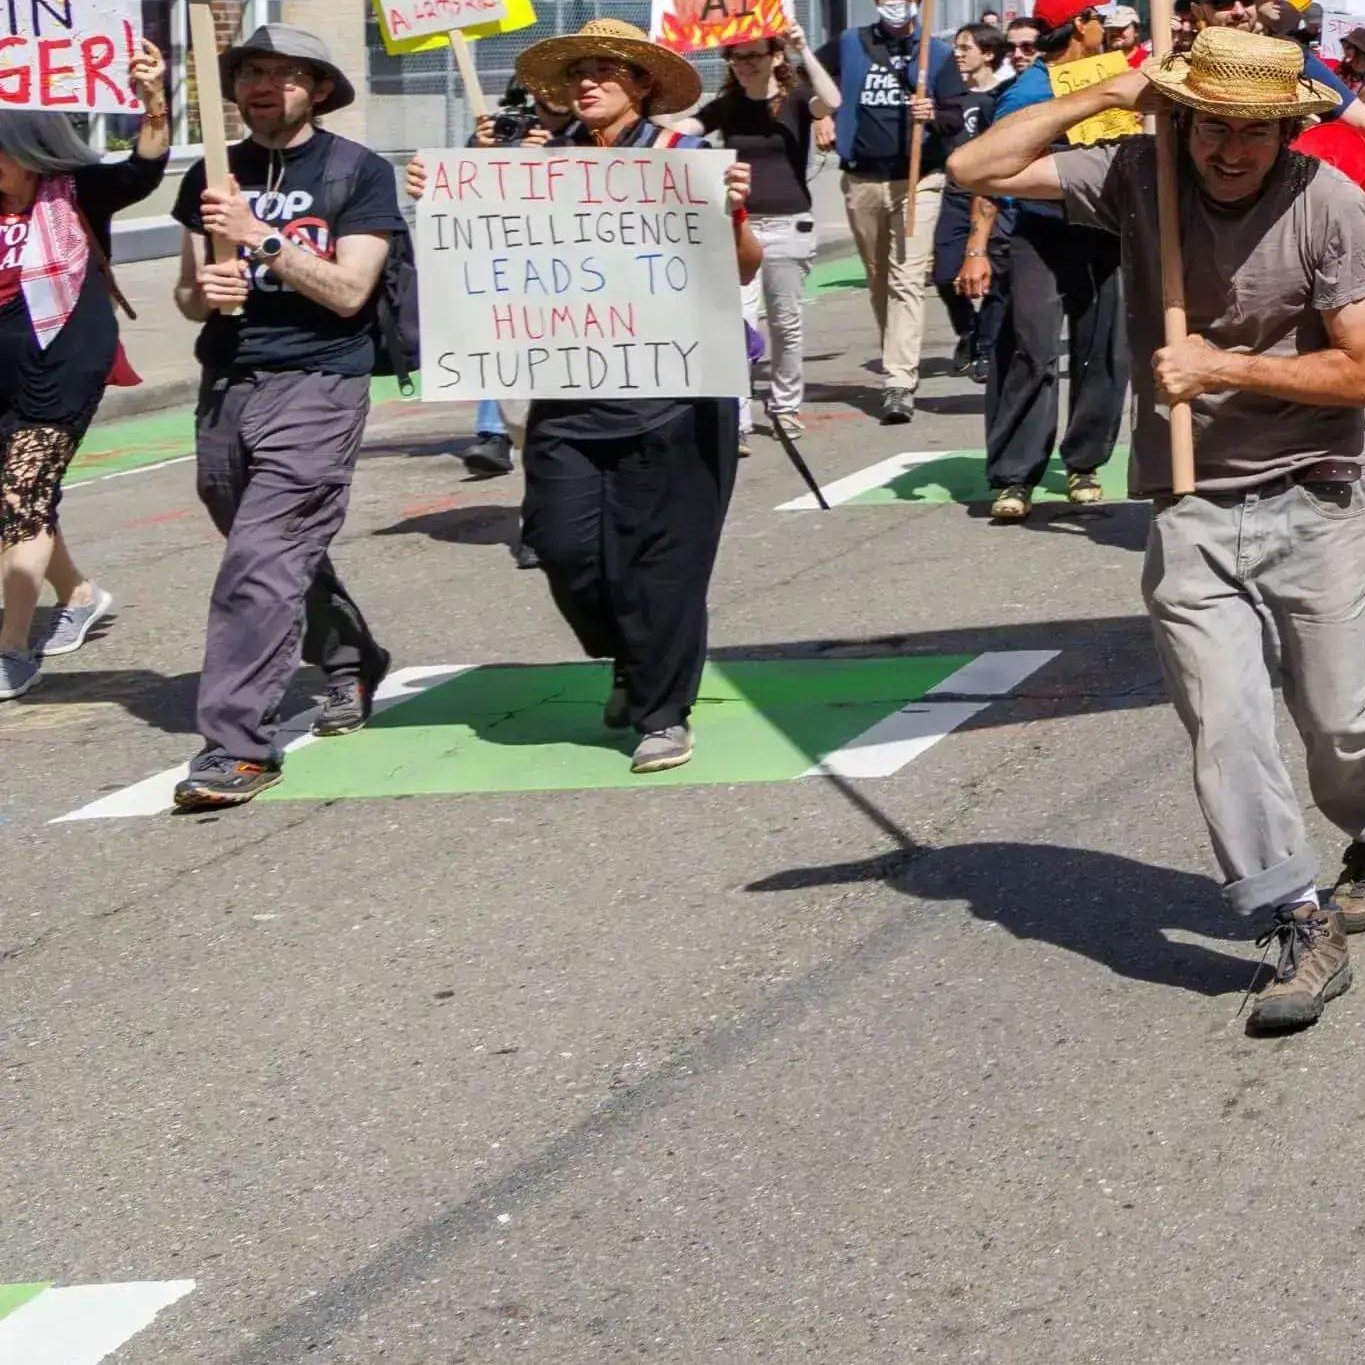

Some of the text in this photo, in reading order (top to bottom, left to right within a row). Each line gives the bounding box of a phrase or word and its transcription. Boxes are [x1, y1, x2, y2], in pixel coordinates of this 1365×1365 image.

[865, 72, 899, 90] THE
[432, 160, 708, 205] ARTIFICIAL
[238, 190, 313, 221] TOP
[431, 211, 703, 250] INTELLIGENCE
[464, 254, 688, 295] LEADS TO
[493, 303, 636, 340] HUMAN
[437, 341, 699, 390] STUPIDITY
